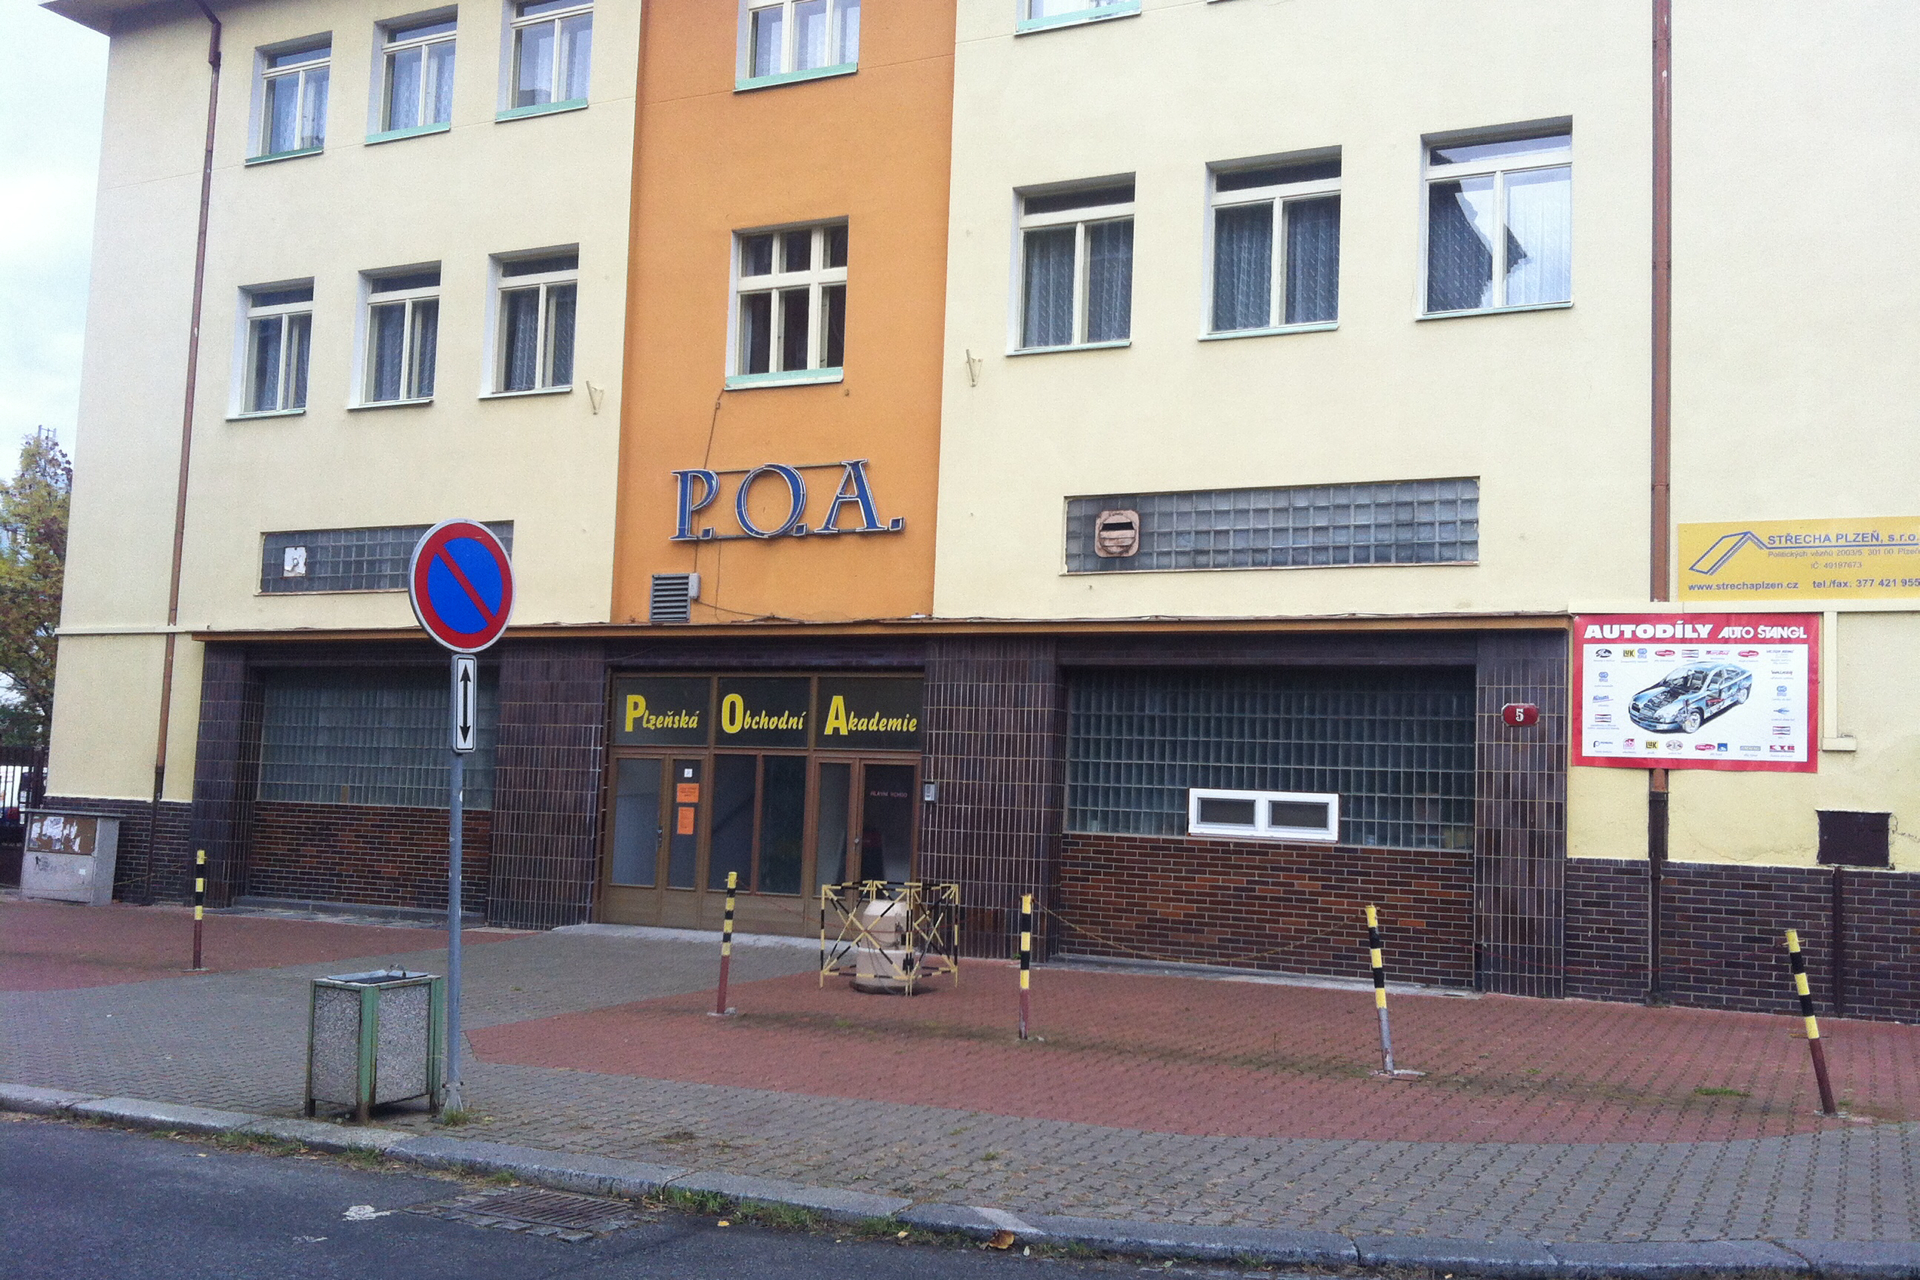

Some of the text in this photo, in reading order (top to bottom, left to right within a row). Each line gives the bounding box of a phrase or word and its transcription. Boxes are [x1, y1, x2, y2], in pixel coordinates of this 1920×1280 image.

[669, 458, 905, 541] P.O.A.
[1767, 532, 1832, 545] STŘECHA
[1836, 530, 1884, 544] PLZEŇ,
[1768, 550, 1808, 559] Politických
[1868, 548, 1881, 556] 301
[1688, 580, 1799, 591] www.strechaplzen.cz
[1856, 578, 1875, 588] 377
[1878, 578, 1897, 587] 421
[1901, 577, 1920, 587] 955
[1584, 620, 1808, 639] AUTODÍLY AUTO ŠTANGL
[625, 693, 918, 735] Plzeňská Obchodní Akademie
[1515, 708, 1524, 722] 5
